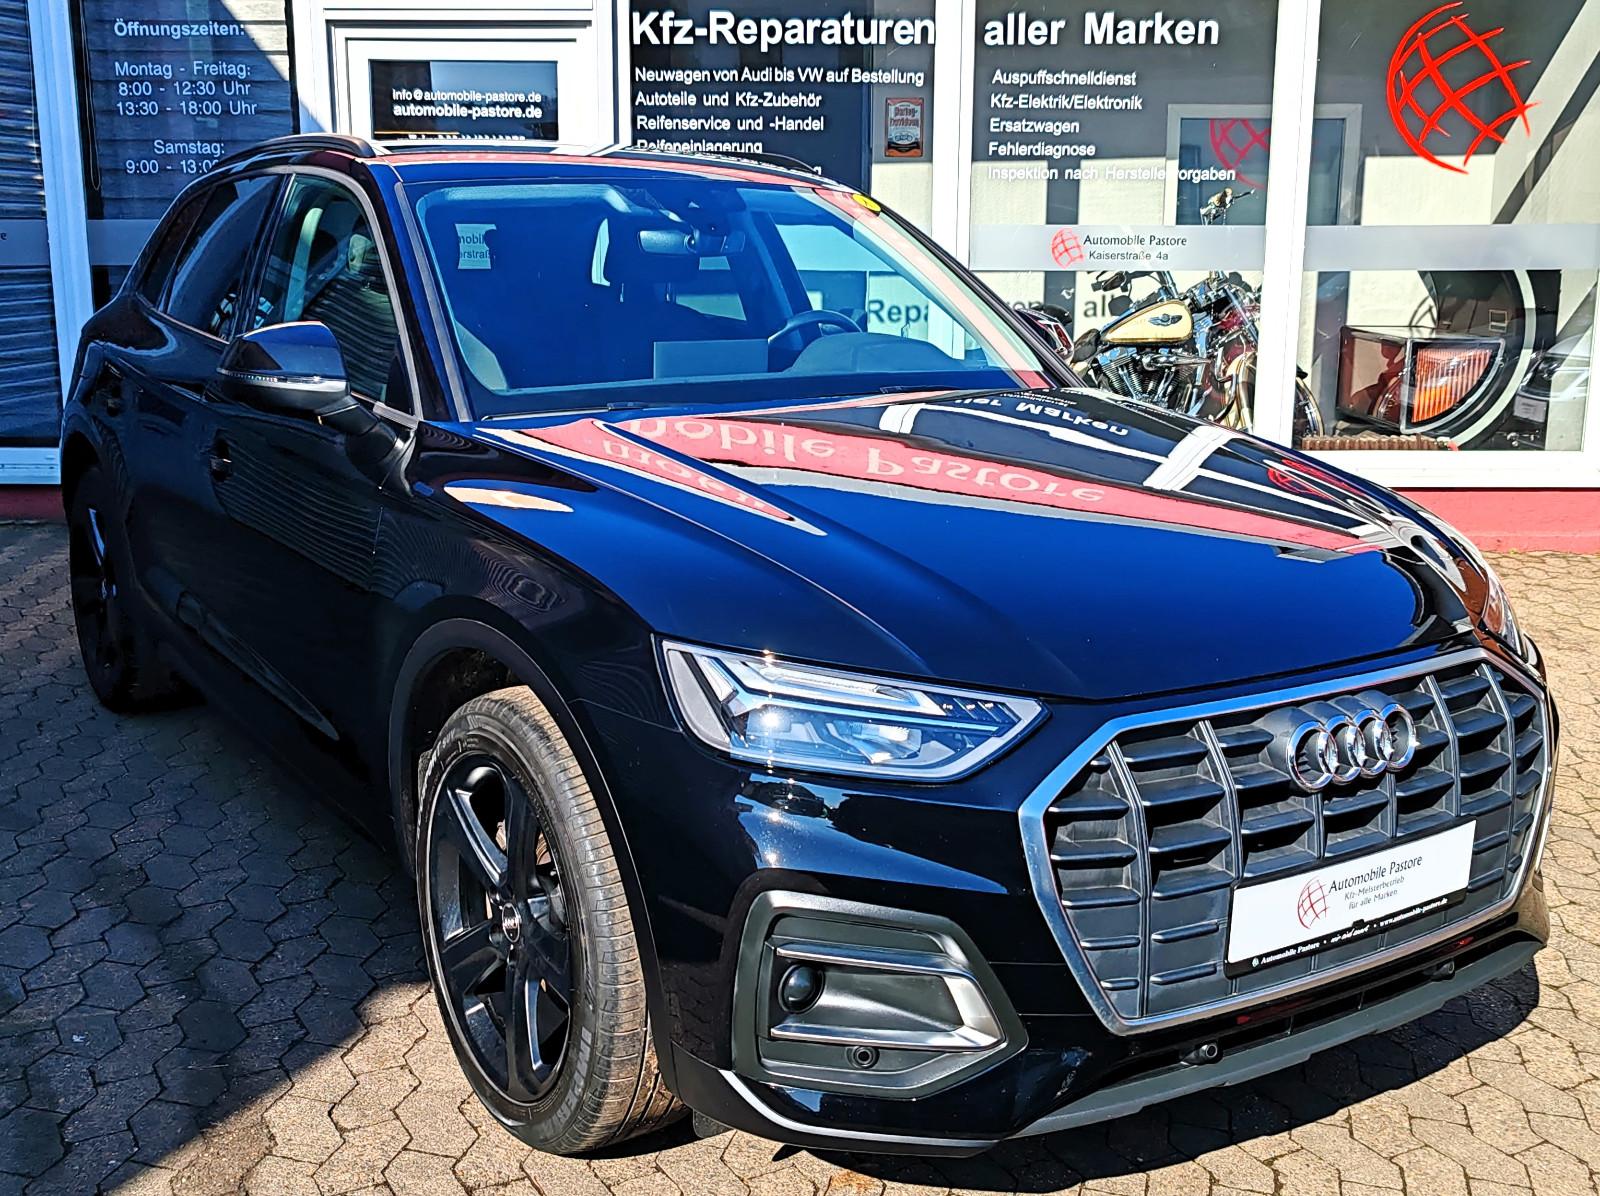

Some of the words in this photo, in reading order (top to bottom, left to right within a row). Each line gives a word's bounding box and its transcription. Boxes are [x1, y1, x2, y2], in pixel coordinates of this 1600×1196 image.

[113, 17, 246, 40] Öffnungszeiten:
[631, 9, 936, 52] Kfz-Reparaturen
[984, 11, 1066, 46] aller
[1084, 11, 1219, 46] Marken
[114, 61, 173, 80] Montag
[193, 60, 252, 80] Freitag:
[634, 66, 711, 84] Neuwagen
[713, 70, 739, 83] von
[741, 67, 773, 83] Audi
[774, 67, 795, 83] bis
[797, 68, 824, 83] VW
[826, 68, 850, 83] auf
[851, 67, 925, 87] Bestellung
[991, 68, 1138, 88] Auspuffschnelldienst
[118, 81, 153, 97] 8:00
[173, 80, 216, 96] 12:30
[223, 80, 252, 96] Uhr
[392, 87, 543, 104] info@automobile-pastore.de
[116, 101, 159, 116] 13:30
[179, 100, 223, 116] 18:00
[229, 100, 258, 116] Uhr
[635, 90, 697, 108] Autoteile
[702, 91, 729, 107] und
[735, 91, 822, 108] Kfz-Zubehör
[990, 93, 1144, 111] Kfz-Elektrik/Elektronik
[392, 102, 544, 121] automobile-pastore.de
[636, 115, 731, 131] Reifenservice
[737, 115, 764, 131] und
[768, 116, 825, 132] -Handel
[989, 117, 1081, 136] Ersatzwagen
[153, 139, 226, 157] Samstag:
[987, 141, 1097, 159] Fehlerdiagnose
[125, 159, 159, 174] 9:00
[987, 166, 1059, 183] Inspektion
[1064, 166, 1099, 181] nach
[1104, 166, 1237, 184] Herstelleorgaben
[1083, 233, 1146, 247] Automobile
[1149, 234, 1188, 247] Pastore
[1088, 249, 1152, 262] Kaiserstraße
[1155, 250, 1169, 262] 4a
[1328, 865, 1387, 894] Automobile
[1388, 855, 1423, 876] Pastore
[1360, 896, 1372, 907] alle
